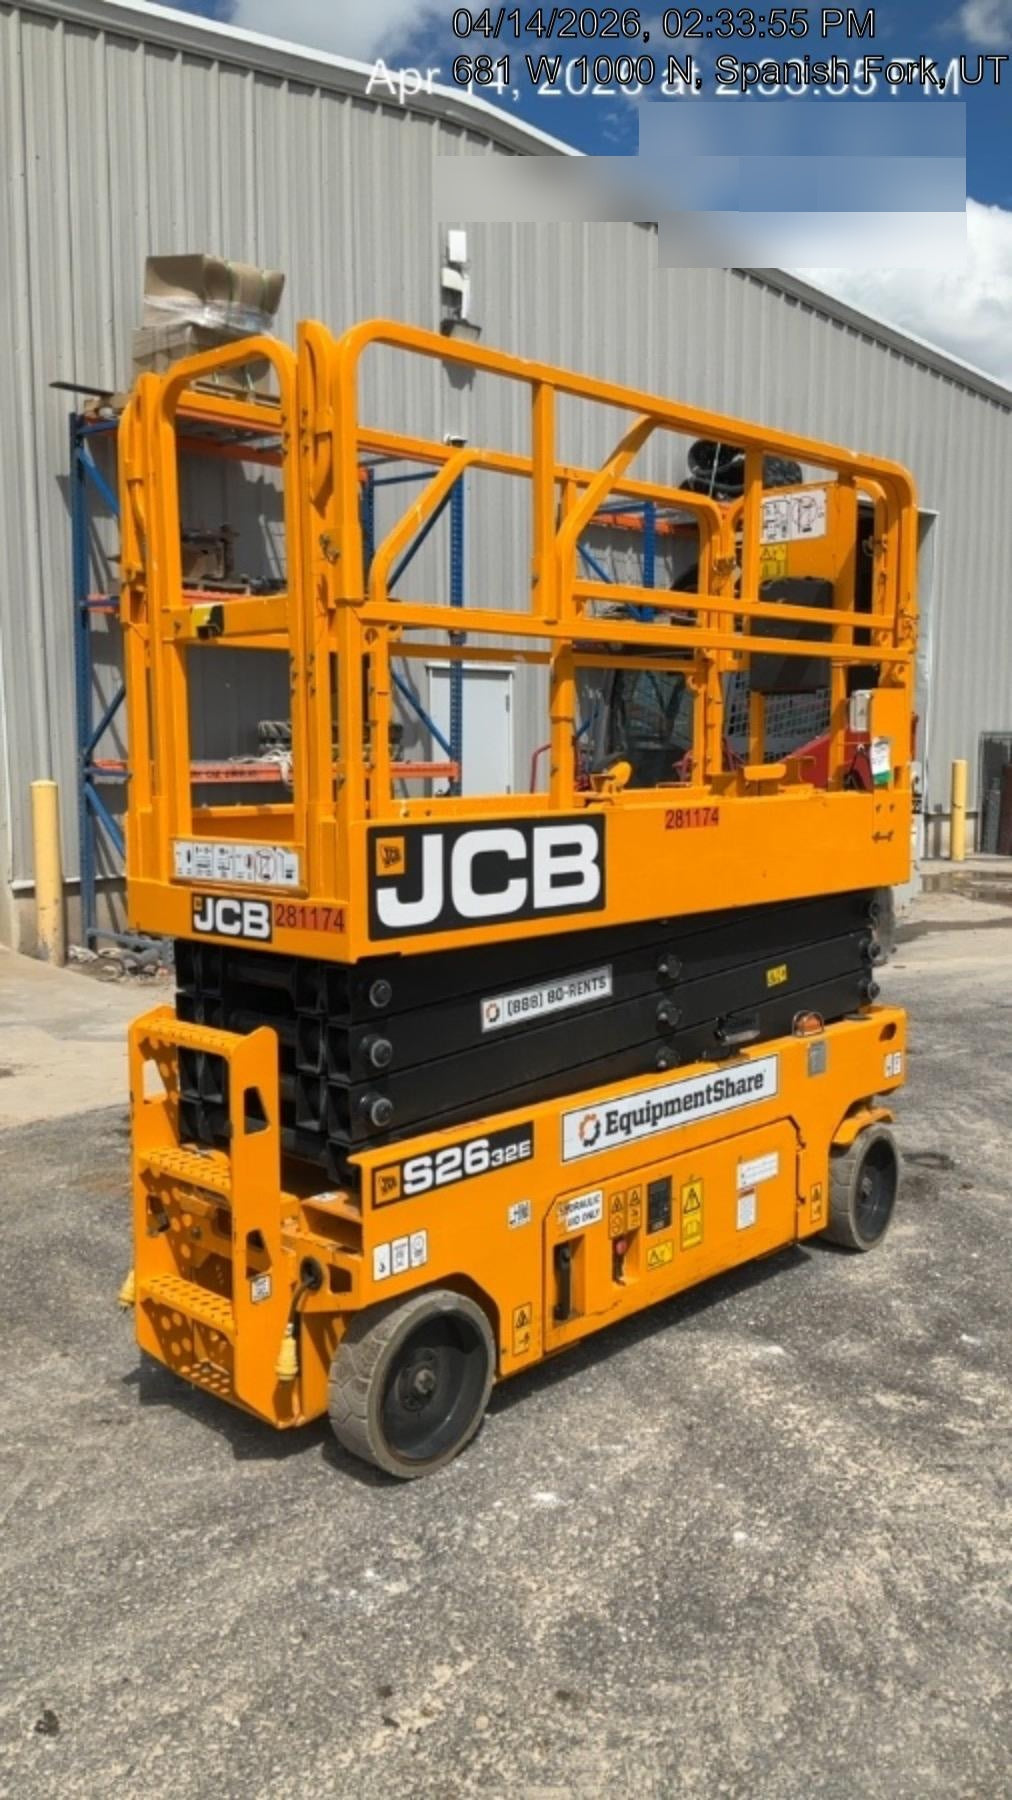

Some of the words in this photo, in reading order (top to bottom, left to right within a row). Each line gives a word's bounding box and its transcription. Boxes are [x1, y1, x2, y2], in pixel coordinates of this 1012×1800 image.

[664, 807, 719, 829] 281174
[376, 824, 601, 927] JCB
[193, 897, 270, 938] JCB
[275, 903, 345, 932] 281174
[605, 1072, 764, 1135] EquipmentShare
[403, 1138, 490, 1195] S26
